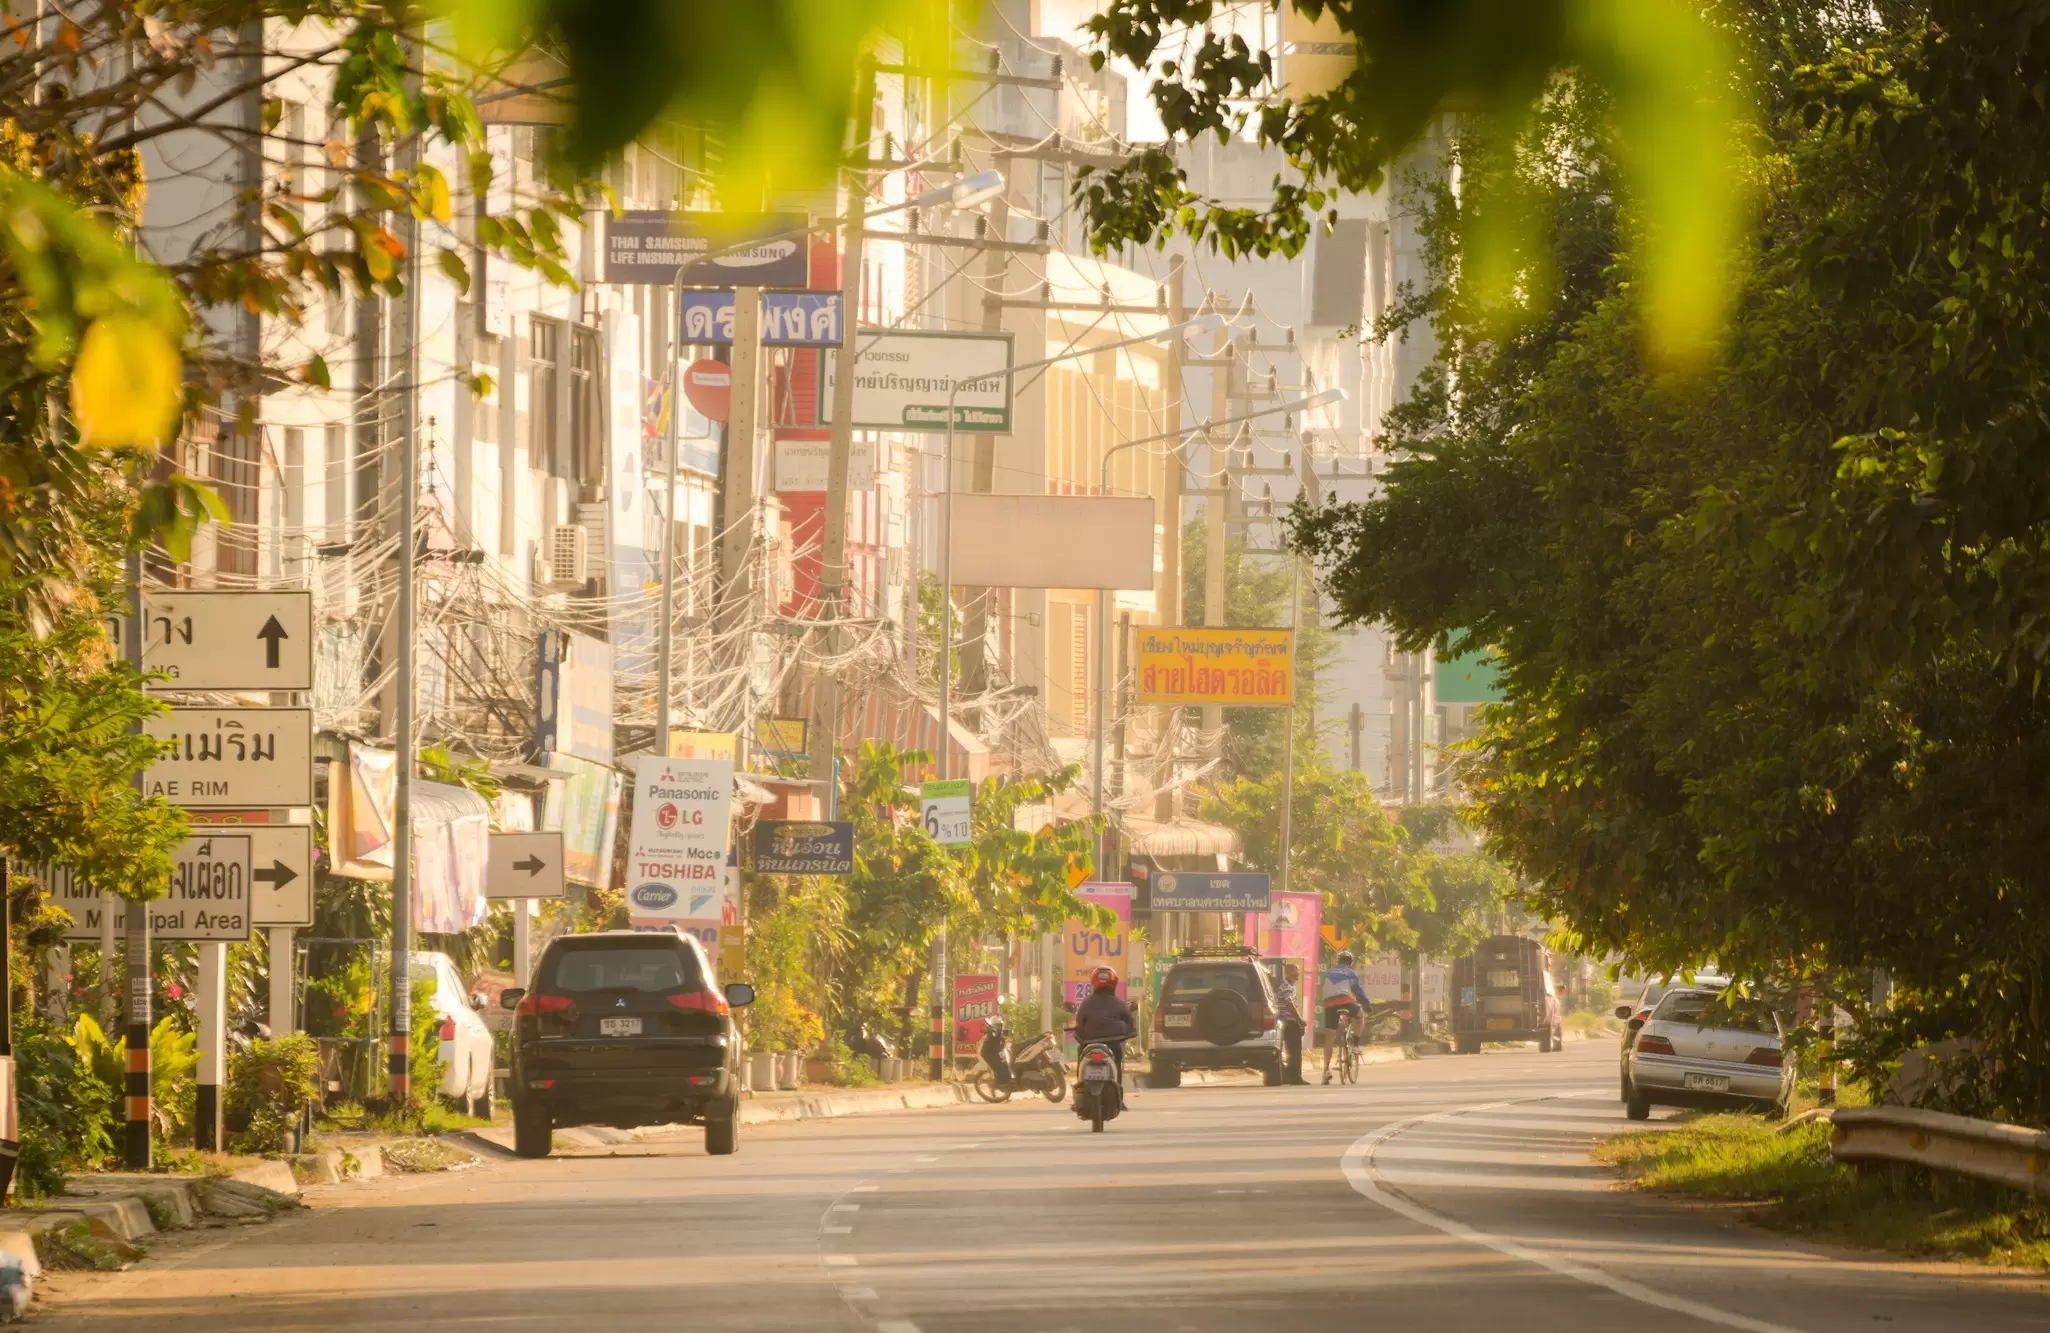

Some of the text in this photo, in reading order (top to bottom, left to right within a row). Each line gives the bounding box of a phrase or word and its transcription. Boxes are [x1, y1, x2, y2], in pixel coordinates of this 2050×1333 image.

[611, 236, 708, 250] THAI SAMSUNG
[610, 251, 634, 264] LIFE
[720, 247, 788, 259] AMSUNG
[146, 780, 230, 797] AE RIM
[649, 785, 720, 801] Panasonic
[681, 810, 704, 826] LG
[638, 862, 717, 880] TOSHIBA
[637, 889, 673, 902] Carrier
[194, 909, 242, 929] Area
[1072, 930, 1122, 957] บ้าน
